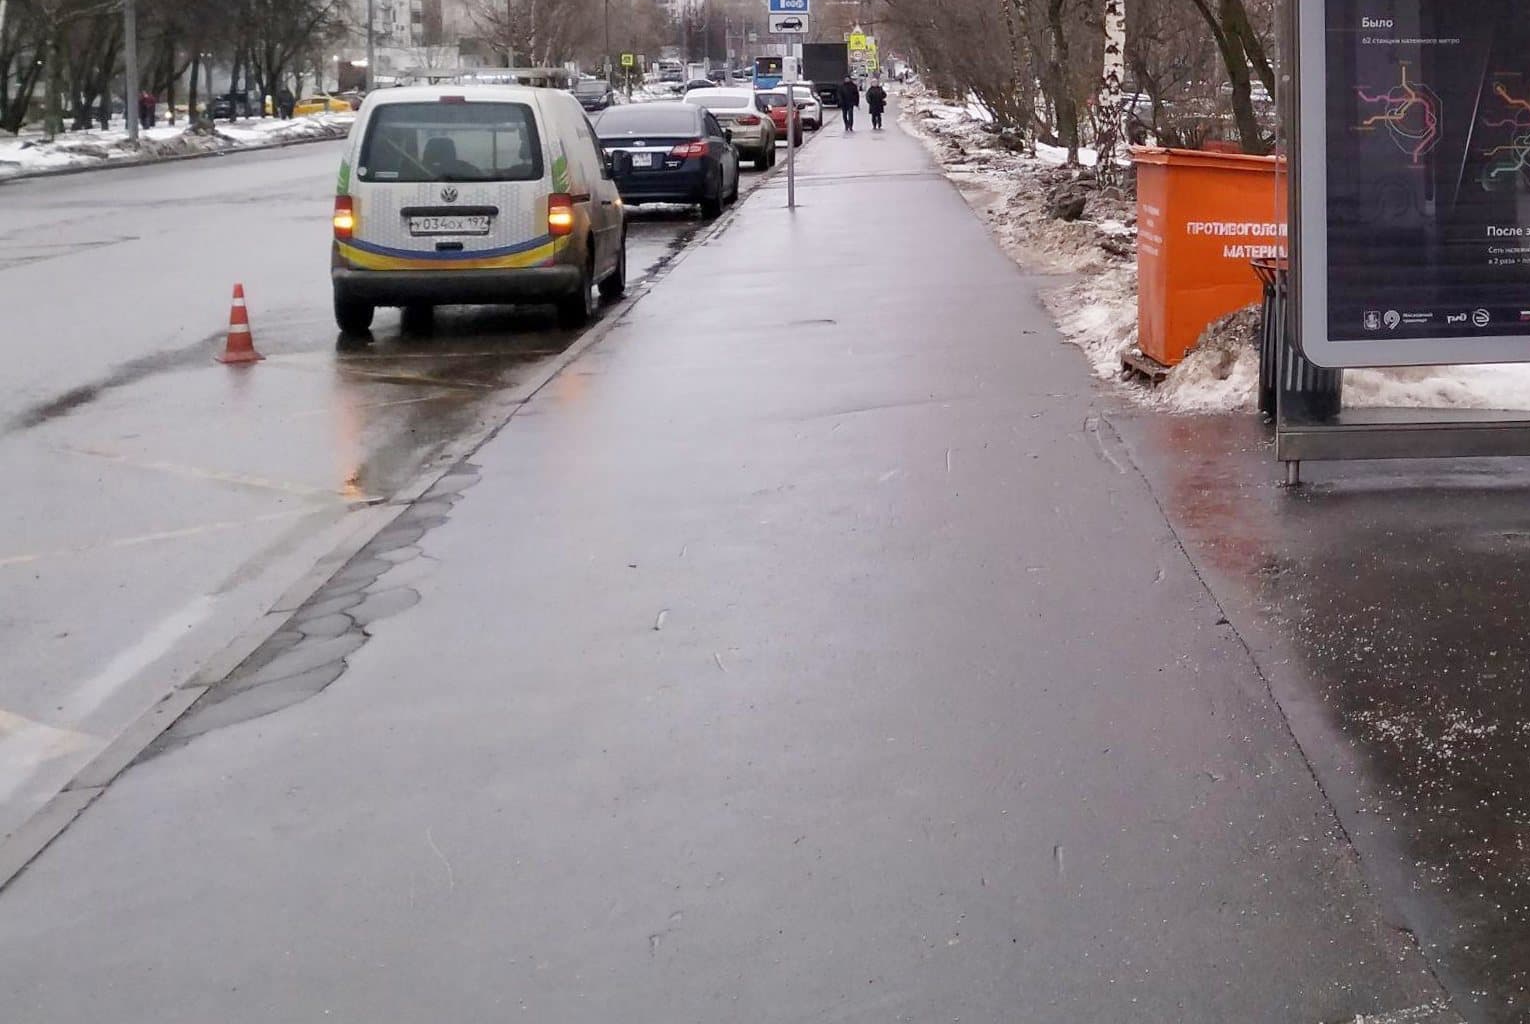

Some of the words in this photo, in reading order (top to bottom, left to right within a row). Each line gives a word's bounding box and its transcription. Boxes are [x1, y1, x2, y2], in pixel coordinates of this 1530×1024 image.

[1361, 16, 1394, 28] Было
[1487, 225, 1523, 237] После
[1223, 245, 1288, 258] МАТЕРИА
